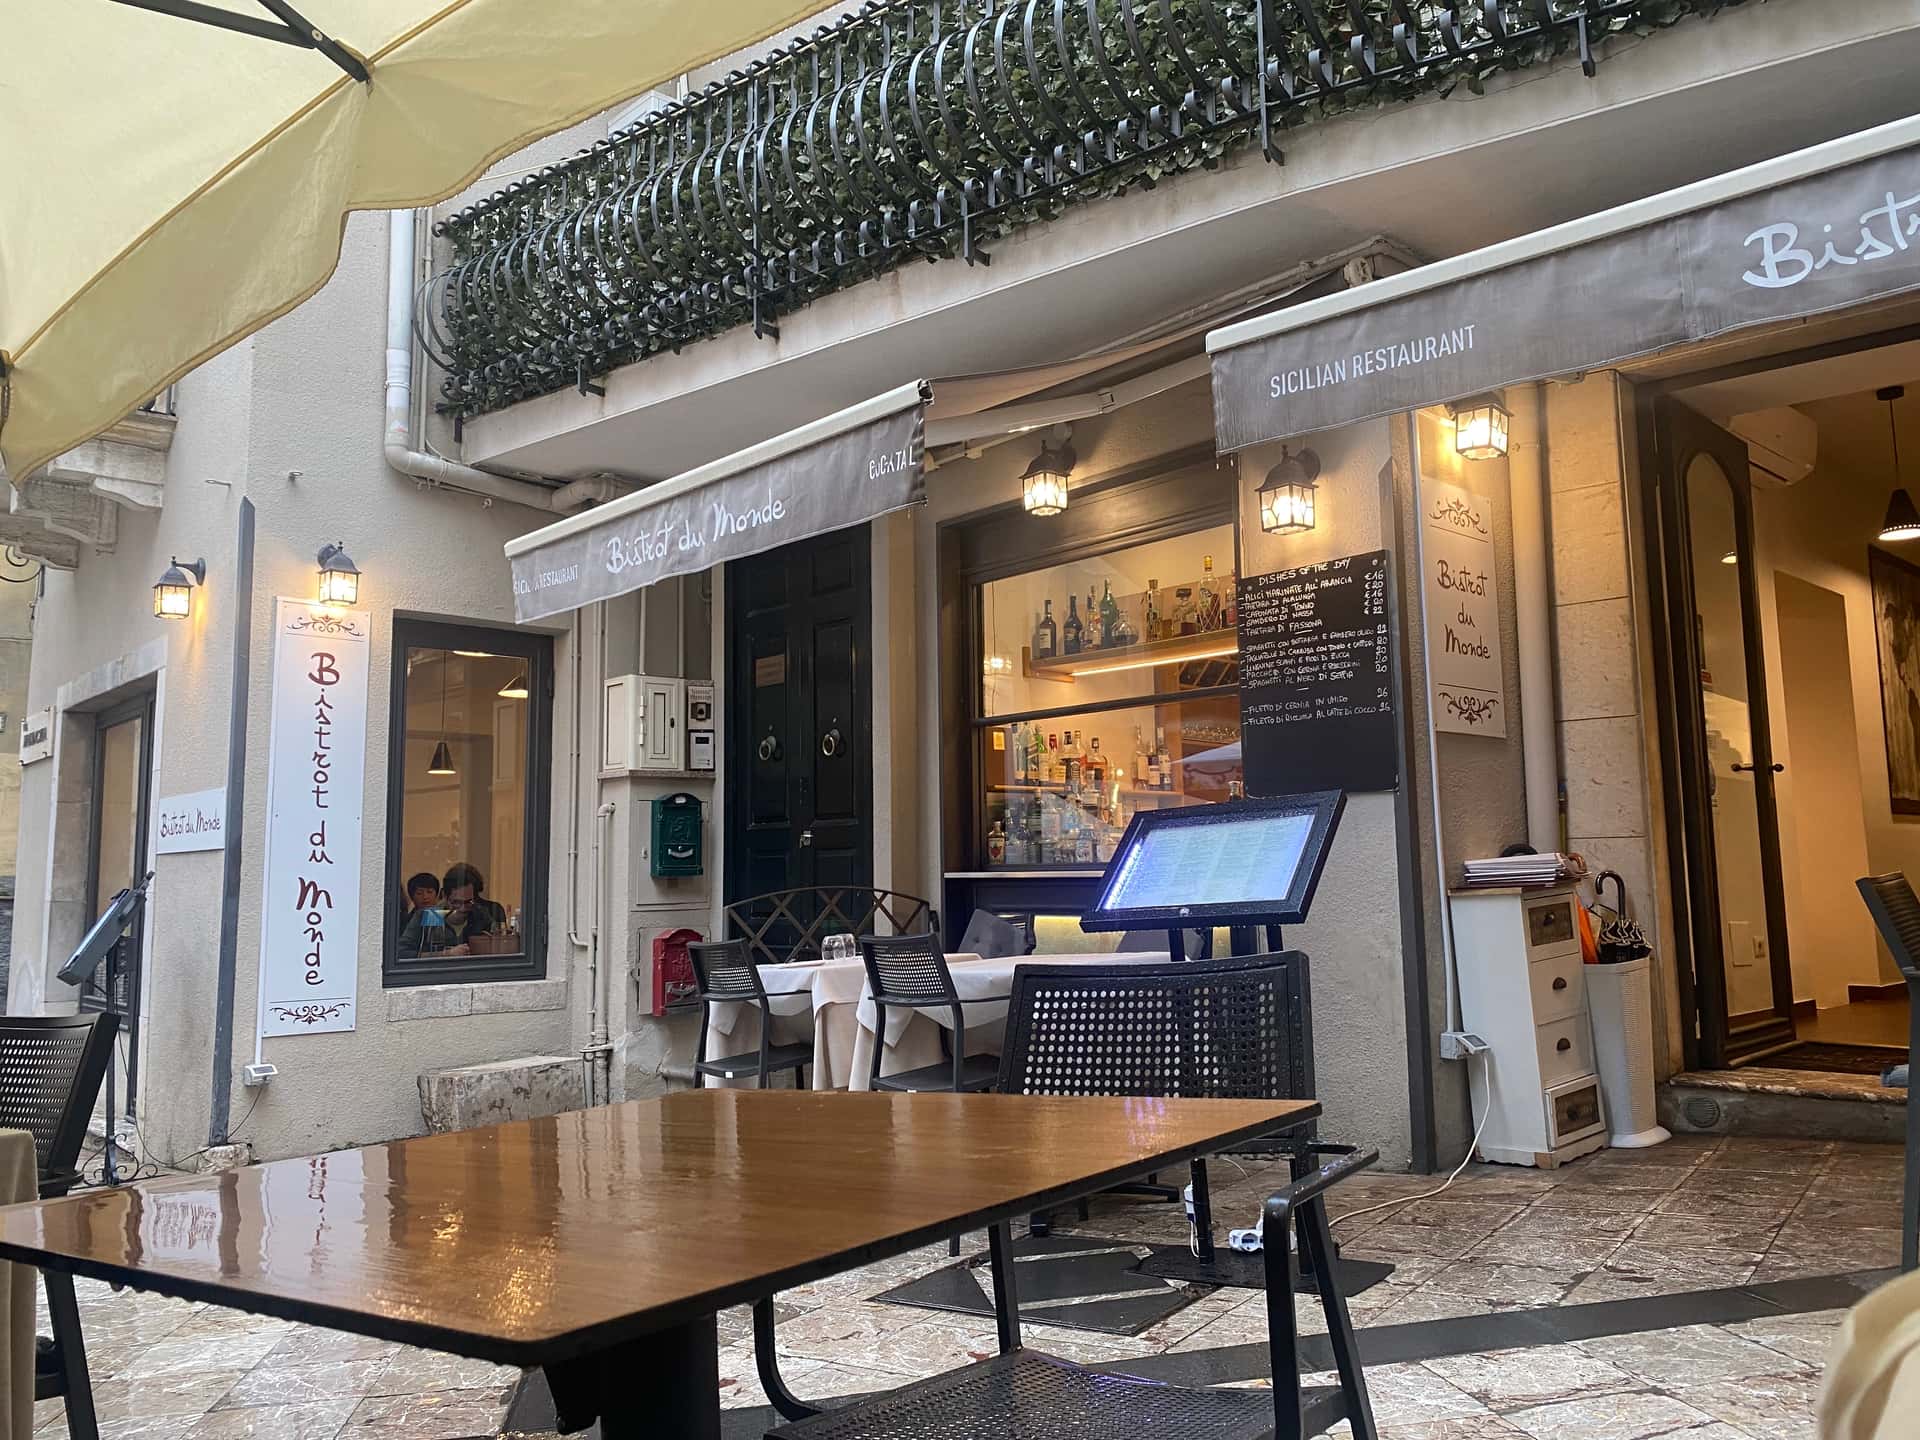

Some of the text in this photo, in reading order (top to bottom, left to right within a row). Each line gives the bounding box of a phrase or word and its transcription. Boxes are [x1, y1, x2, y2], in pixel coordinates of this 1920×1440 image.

[1270, 324, 1476, 398] SICILIAN RESTAURANT
[606, 488, 786, 574] Bistrot du Monde
[1259, 557, 1350, 586] DISHES OF THE DAY
[1436, 559, 1488, 597] Bistrot
[1265, 585, 1303, 598] MARINATE
[1458, 603, 1475, 628] du
[1444, 623, 1491, 660] Monde
[308, 652, 340, 810] Bistrot
[196, 808, 221, 834] Monde
[309, 821, 334, 865] du
[296, 876, 334, 986] Monde
